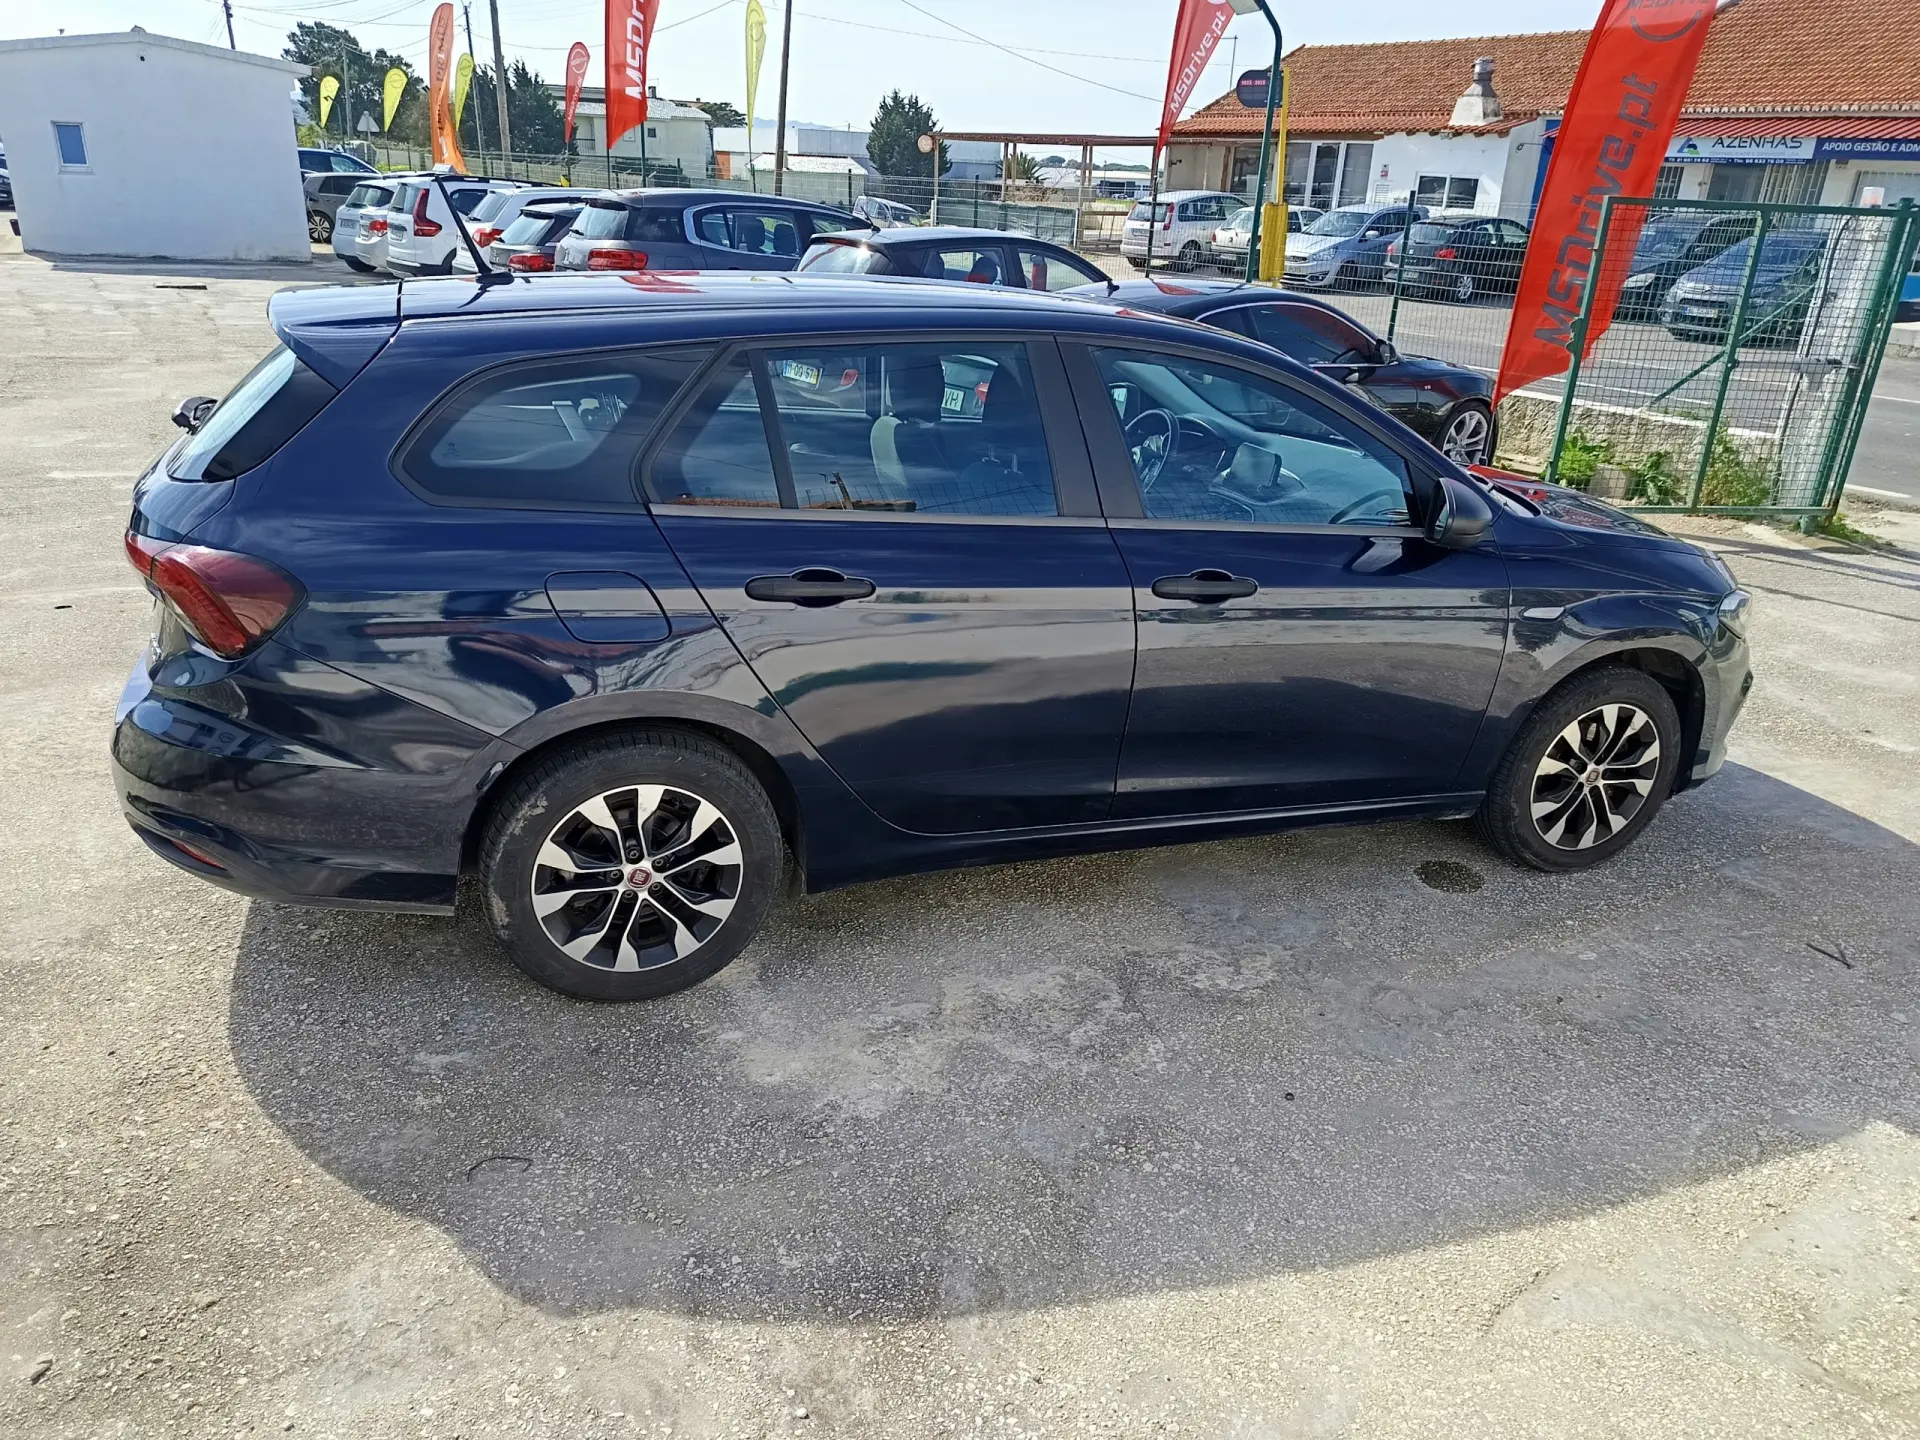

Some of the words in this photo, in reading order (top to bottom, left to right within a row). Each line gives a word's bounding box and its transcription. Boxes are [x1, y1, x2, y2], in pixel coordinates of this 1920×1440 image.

[625, 0, 644, 100] MSDr
[1170, 10, 1226, 113] MSDrive.pt
[1711, 135, 1803, 149] AZENHAS
[1822, 142, 1852, 151] APOIO
[1853, 141, 1889, 152] GESTÃO
[1891, 143, 1898, 152] E
